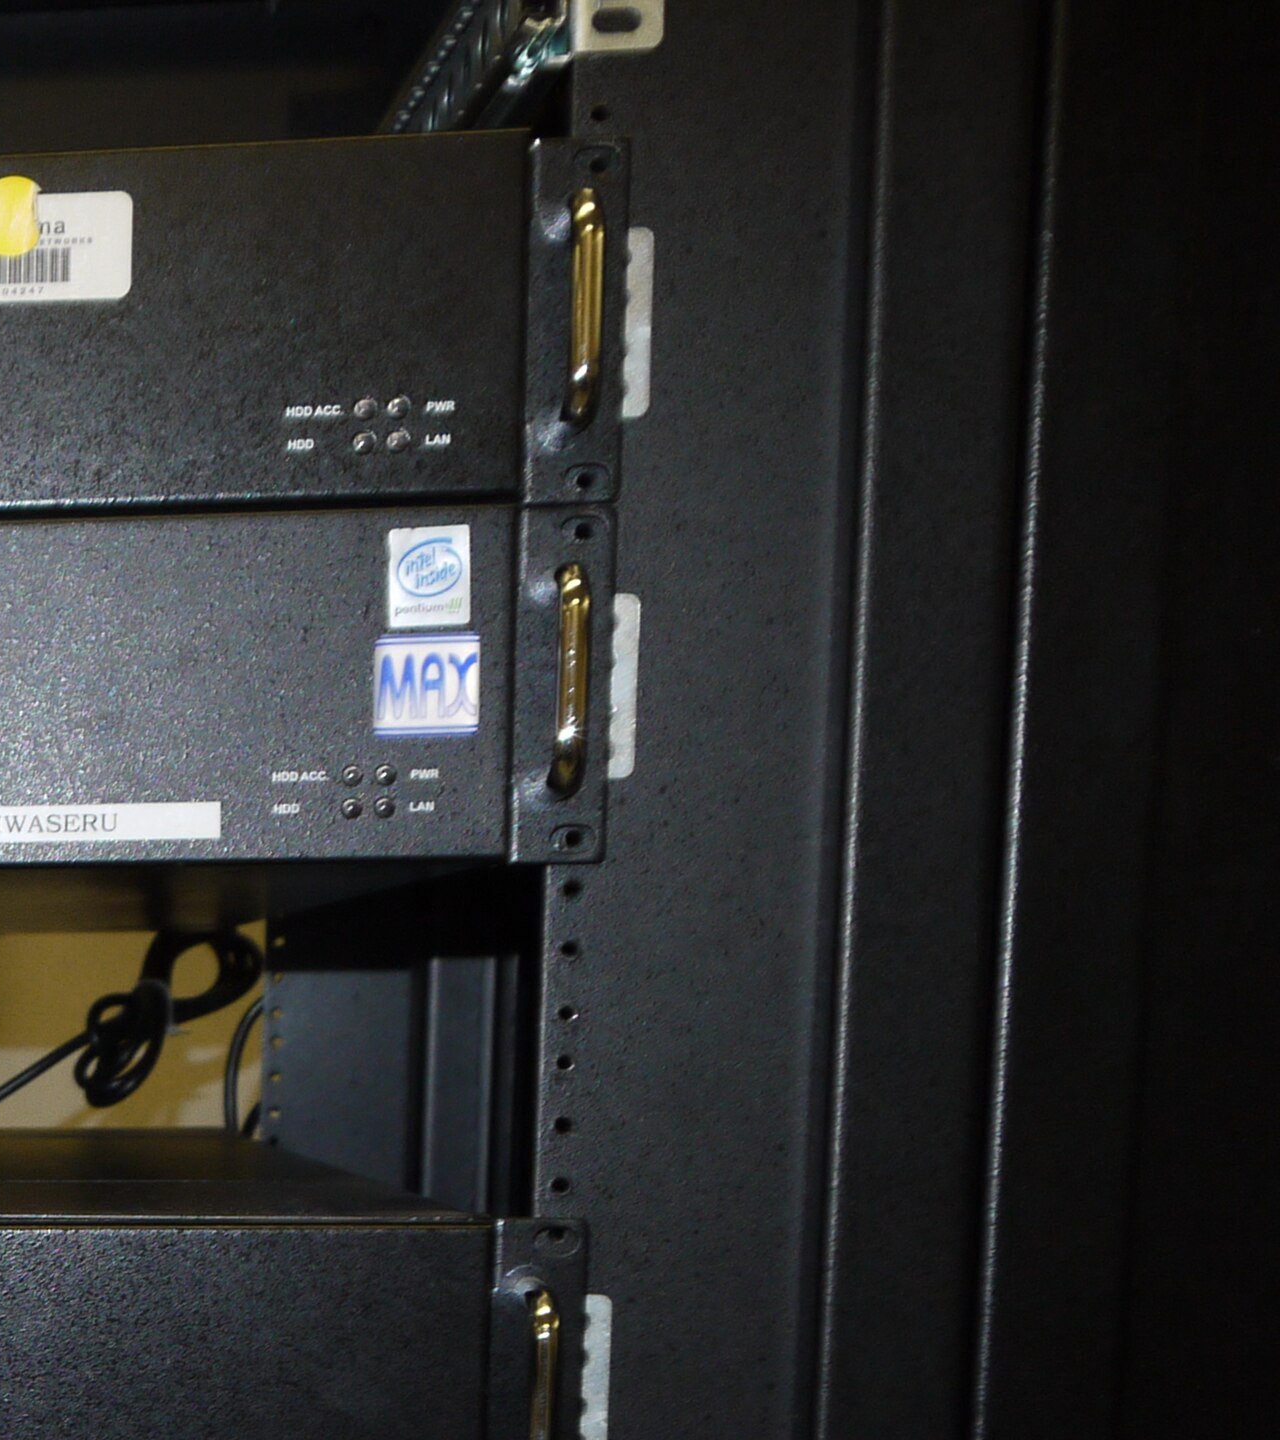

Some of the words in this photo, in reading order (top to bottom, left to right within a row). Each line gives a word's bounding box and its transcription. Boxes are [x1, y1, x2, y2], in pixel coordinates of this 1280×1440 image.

[286, 406, 312, 417] HDD
[426, 400, 455, 412] PWR
[287, 438, 314, 450] HDD
[425, 433, 451, 446] LAN
[406, 547, 436, 576] intel
[415, 561, 456, 590] inside
[394, 601, 444, 617] pentium
[376, 651, 478, 721] MAX
[272, 771, 298, 782] HDD
[410, 768, 439, 779] PWR
[273, 803, 300, 814] HDD
[409, 801, 435, 812] LAN
